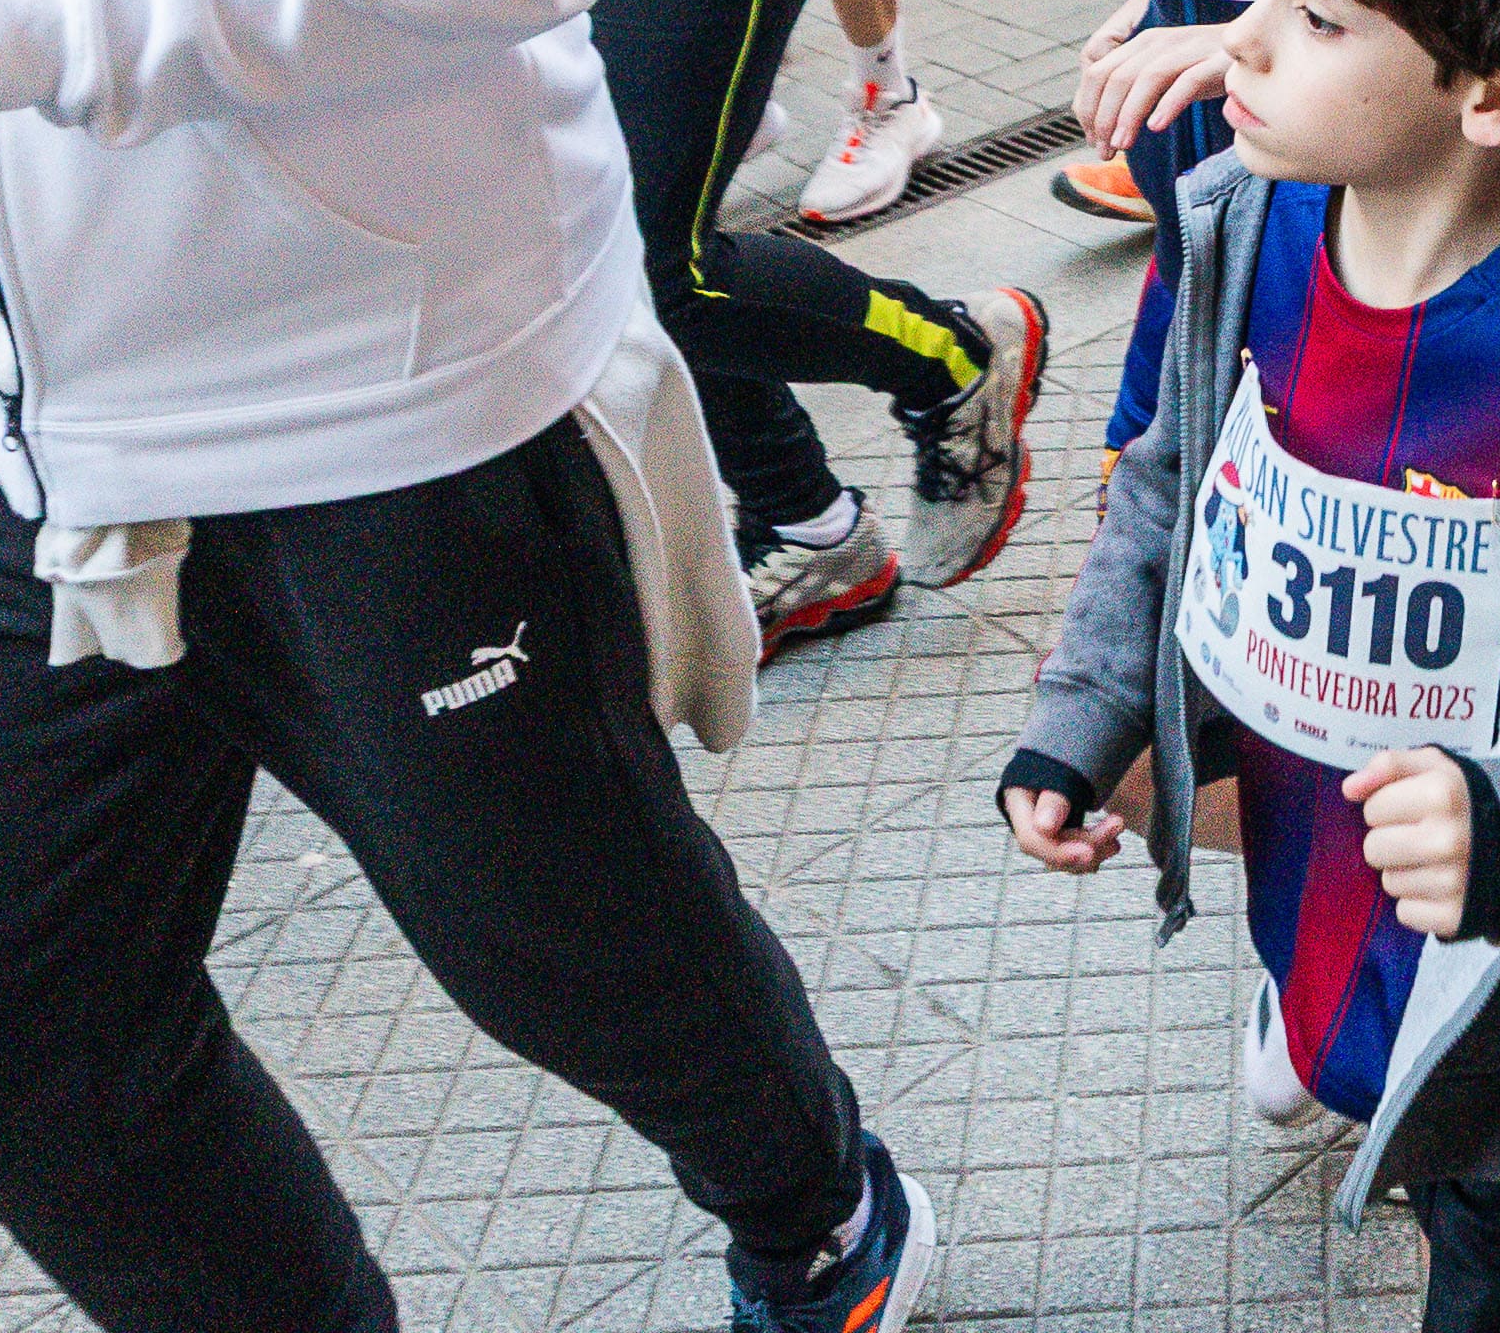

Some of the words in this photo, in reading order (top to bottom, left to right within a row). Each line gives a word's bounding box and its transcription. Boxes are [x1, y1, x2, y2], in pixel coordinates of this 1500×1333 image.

[1245, 437, 1289, 527] SAN
[1298, 486, 1493, 575] SILVESTRE
[1266, 541, 1465, 671] 3110
[420, 658, 517, 717] PUMA
[1246, 629, 1398, 718] PONTEVEDRA
[1409, 683, 1475, 721] 2025
